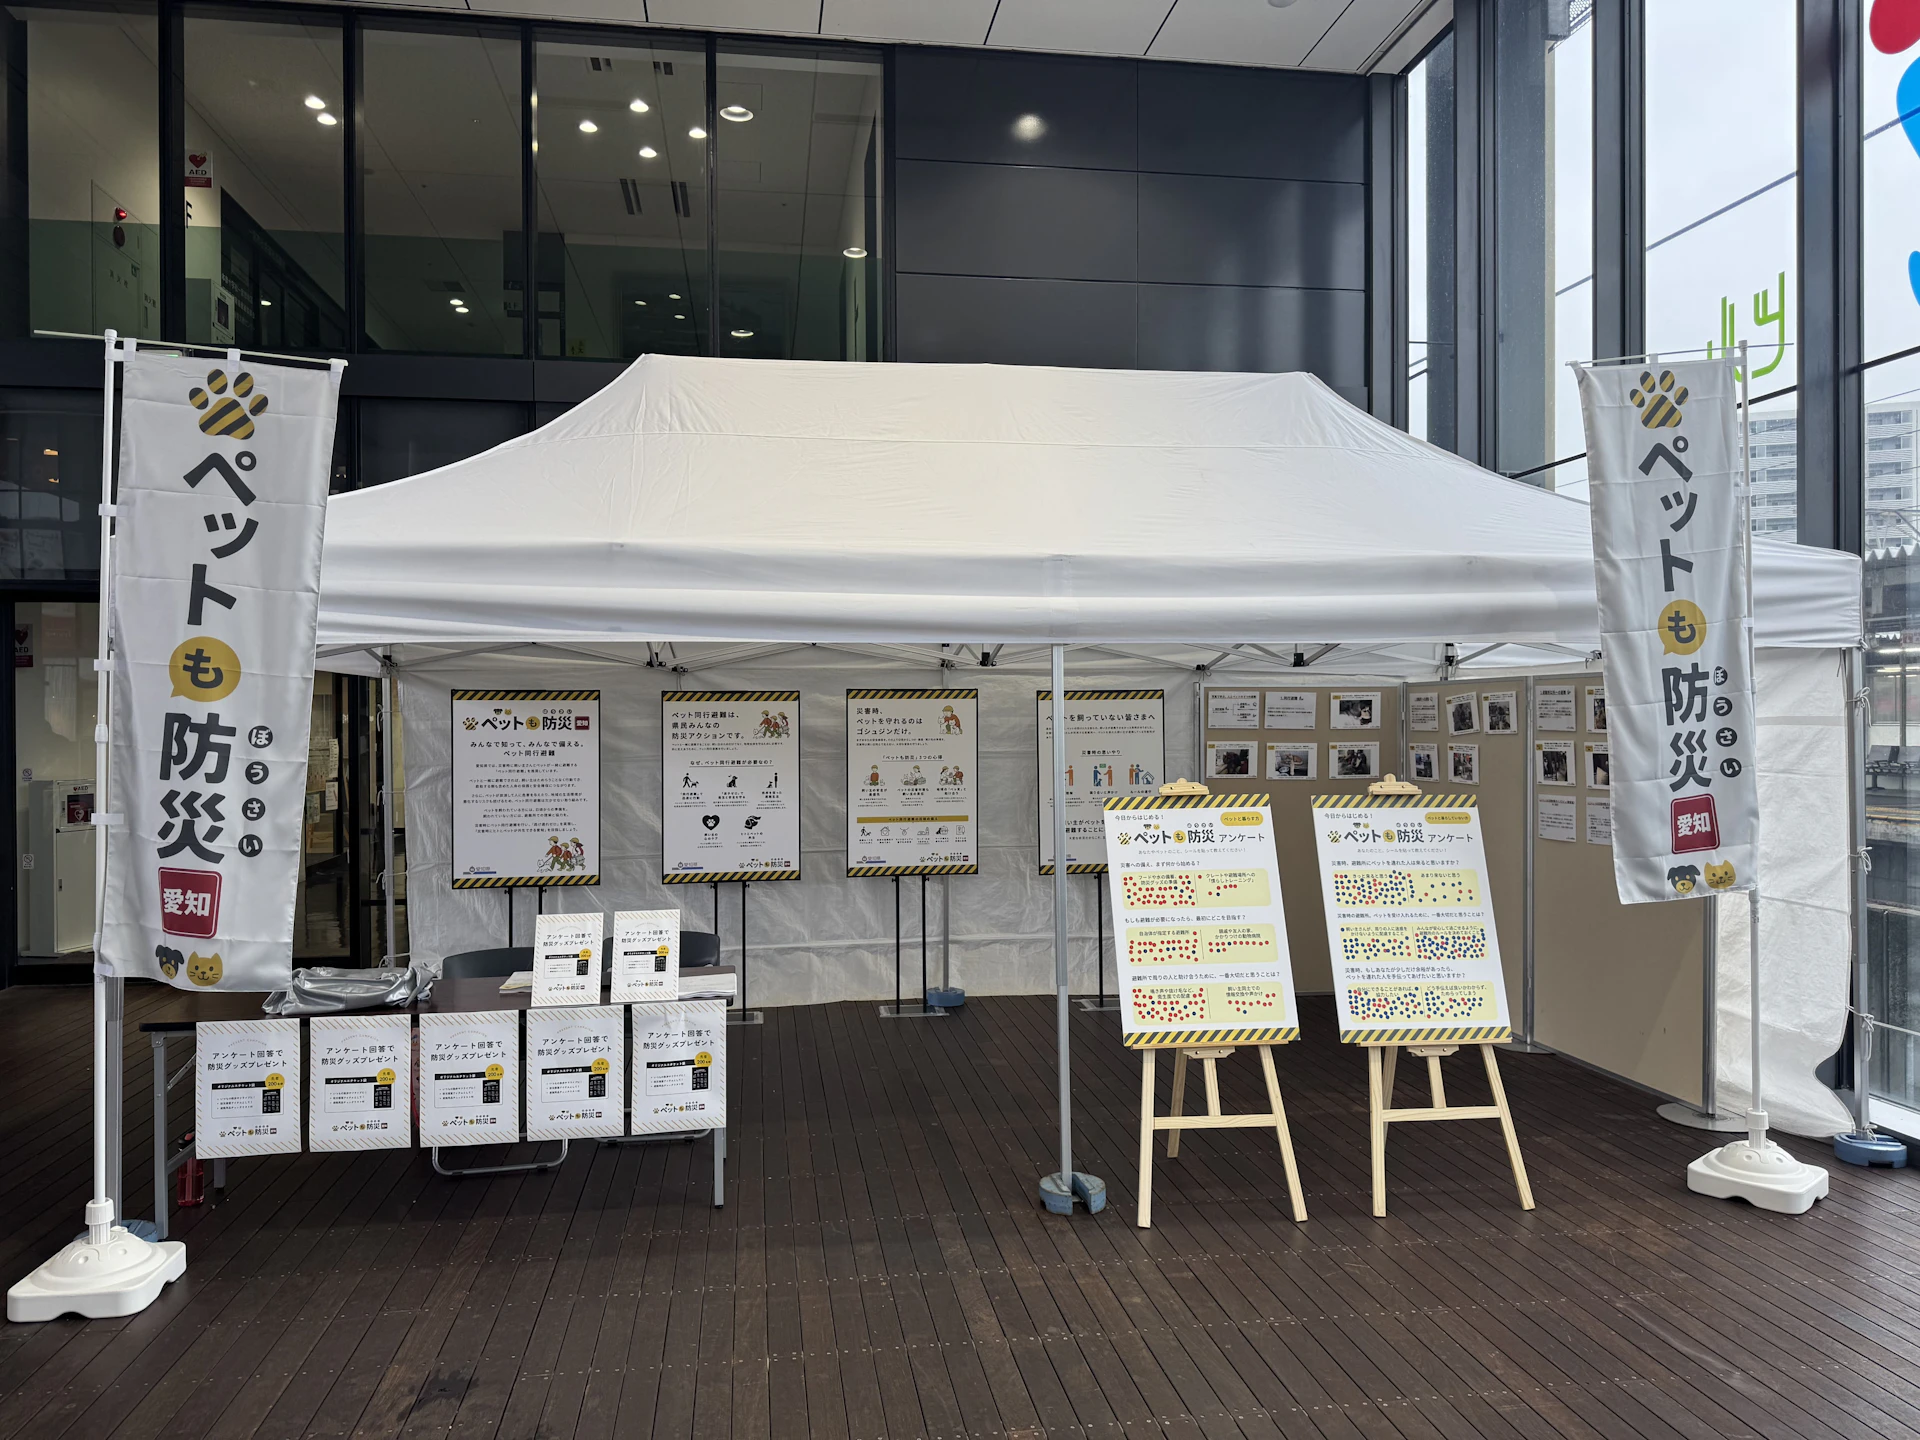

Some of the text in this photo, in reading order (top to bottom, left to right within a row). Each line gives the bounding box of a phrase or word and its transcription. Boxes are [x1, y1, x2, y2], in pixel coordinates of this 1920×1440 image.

[1639, 435, 1712, 793] ペットも防災
[157, 451, 259, 864] ペットも防災
[481, 716, 572, 730] ペットも防災
[1713, 668, 1740, 776] ぼうさい
[243, 727, 271, 853] ぼうさい
[1677, 812, 1711, 838] 愛知
[1134, 830, 1265, 844] ペットも防災 アンケート
[1344, 829, 1473, 843] ペットも防災 アンケート
[163, 888, 211, 916] 愛知
[648, 1030, 711, 1038] アンケート回答で
[436, 1041, 502, 1050] アンケート回答で
[543, 1036, 608, 1045] アンケート回答で
[643, 1040, 714, 1049] 防災グッズプレゼント
[213, 1049, 283, 1060] アンケート回答で
[326, 1045, 395, 1054] アンケート回答で
[538, 1046, 612, 1056] 防災グッズプレゼント
[321, 1056, 398, 1065] 防災グッズプレゼント
[431, 1051, 507, 1061] 防災グッズプレゼント
[208, 1060, 287, 1071] 防災グッズプレゼント
